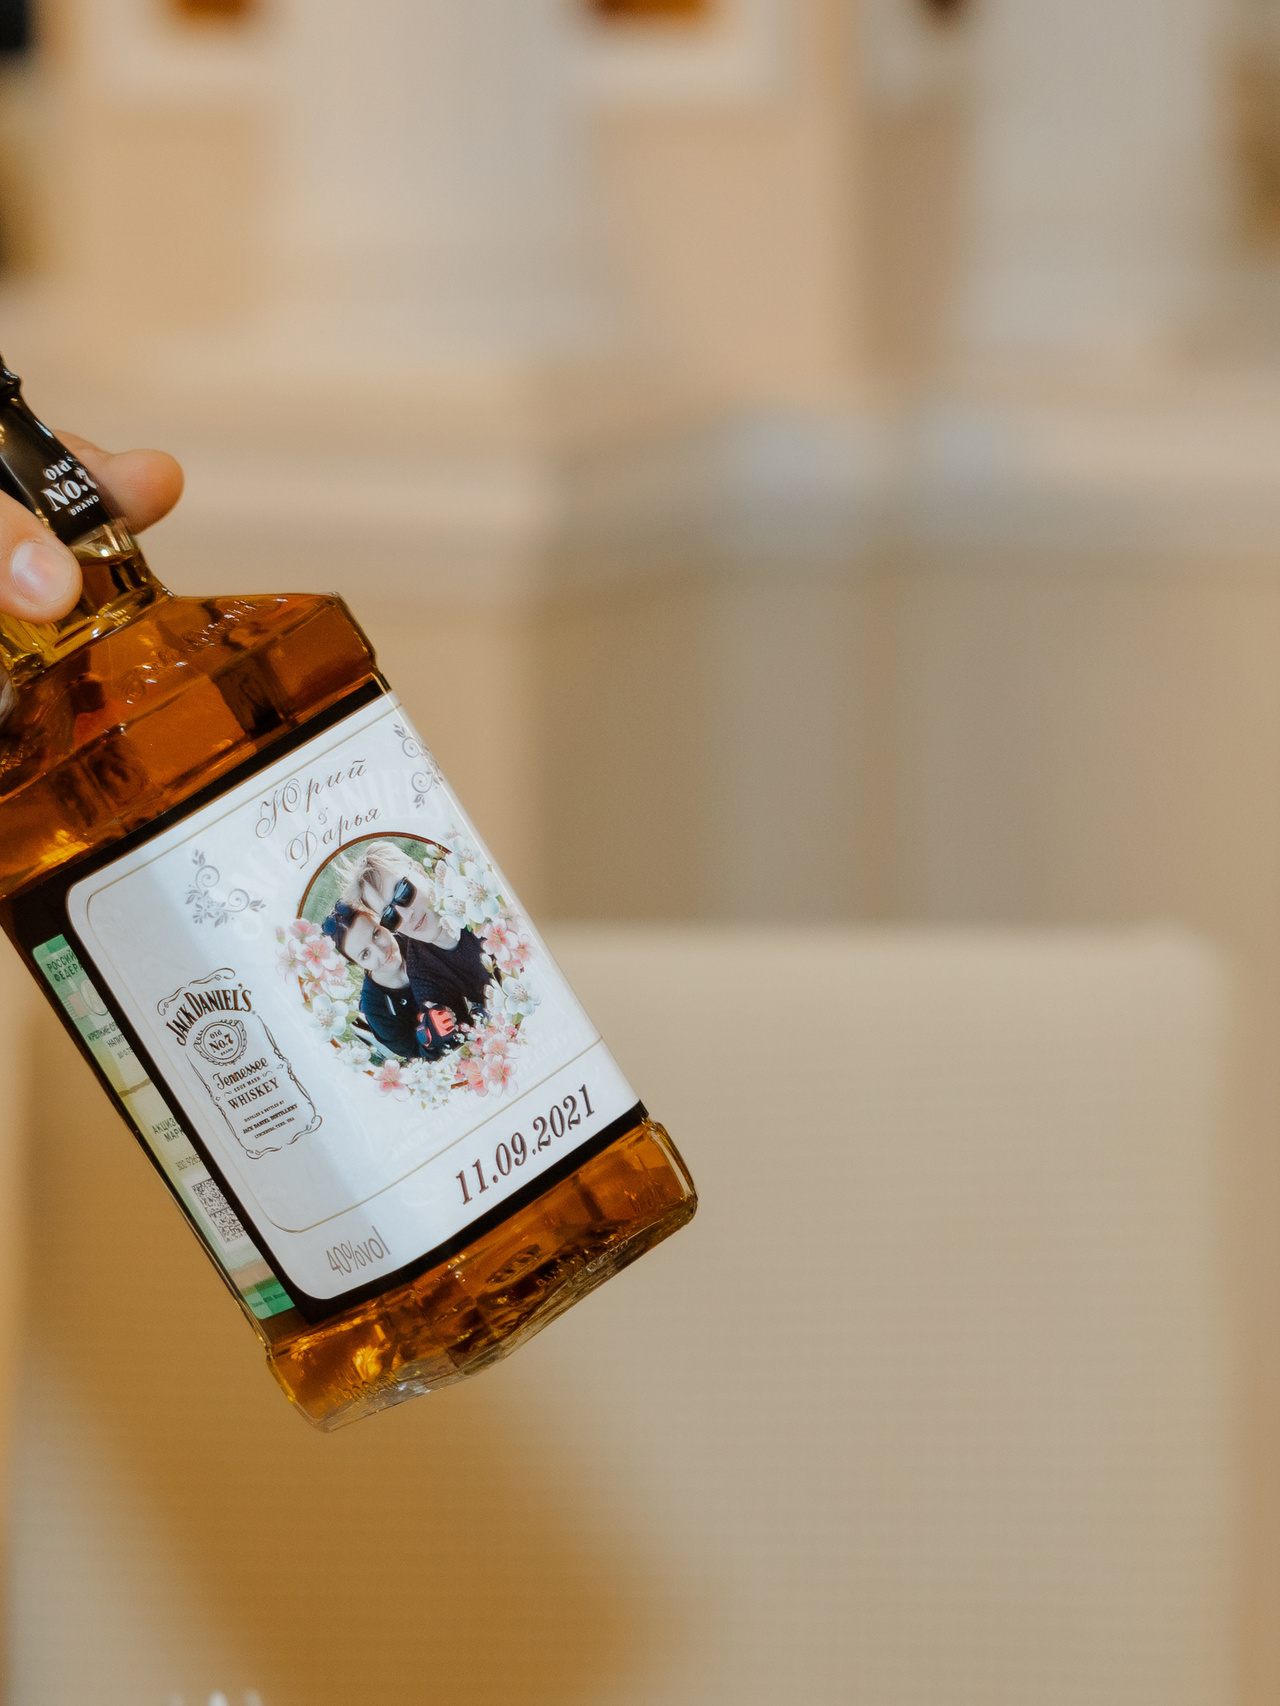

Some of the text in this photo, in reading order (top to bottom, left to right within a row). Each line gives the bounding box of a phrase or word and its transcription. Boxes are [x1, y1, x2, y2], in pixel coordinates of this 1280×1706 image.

[44, 460, 72, 481] Old
[70, 494, 100, 516] BRAND
[254, 758, 367, 839] Юрий
[285, 807, 382, 870] Дарья
[166, 983, 252, 1047] JACK DANIEL'S
[209, 1029, 223, 1040] Old
[212, 1057, 269, 1090] Tennessee
[227, 1077, 279, 1110] WHISKEY
[242, 1125, 254, 1134] JACK
[455, 1083, 596, 1205] 11.09.2021
